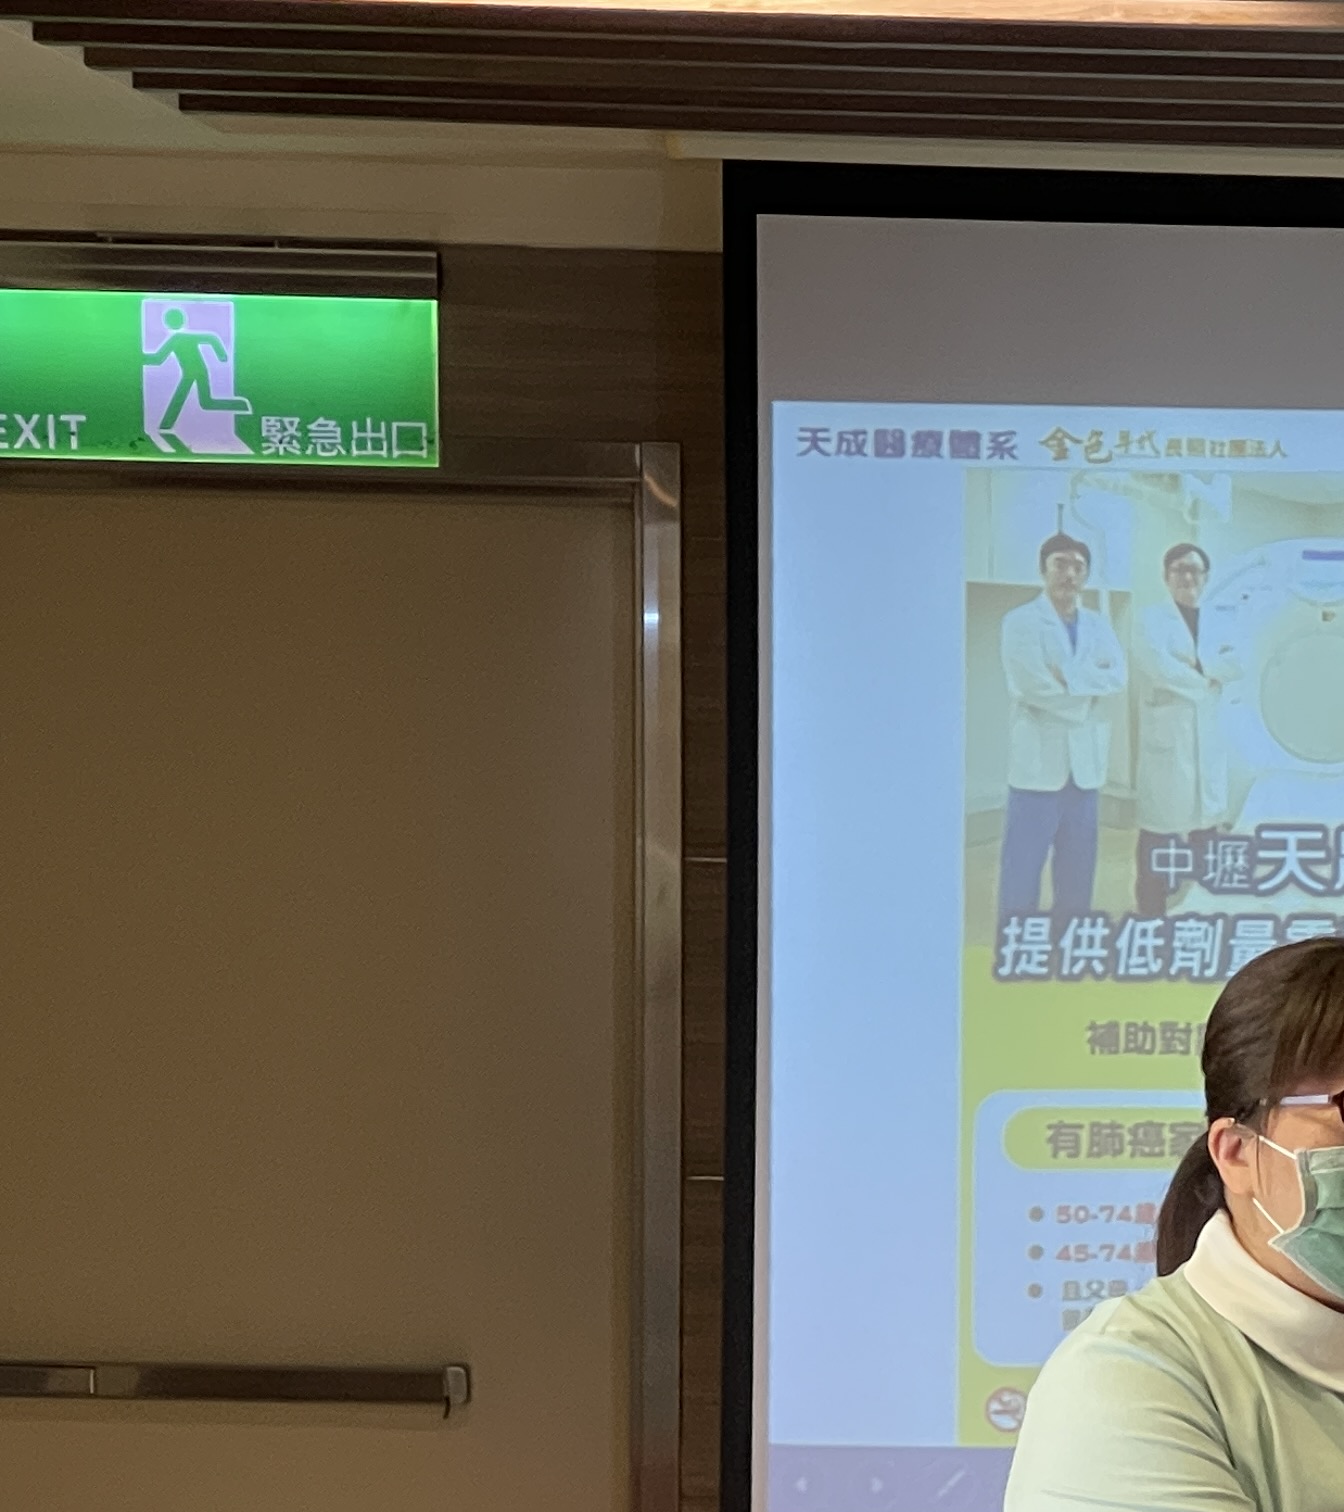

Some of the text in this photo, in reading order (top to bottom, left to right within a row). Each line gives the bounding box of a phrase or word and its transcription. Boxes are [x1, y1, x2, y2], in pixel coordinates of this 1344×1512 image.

[261, 416, 428, 458] 緊急出口
[796, 426, 1020, 460] 天成醫療體系
[1086, 1021, 1207, 1056] 補助對
